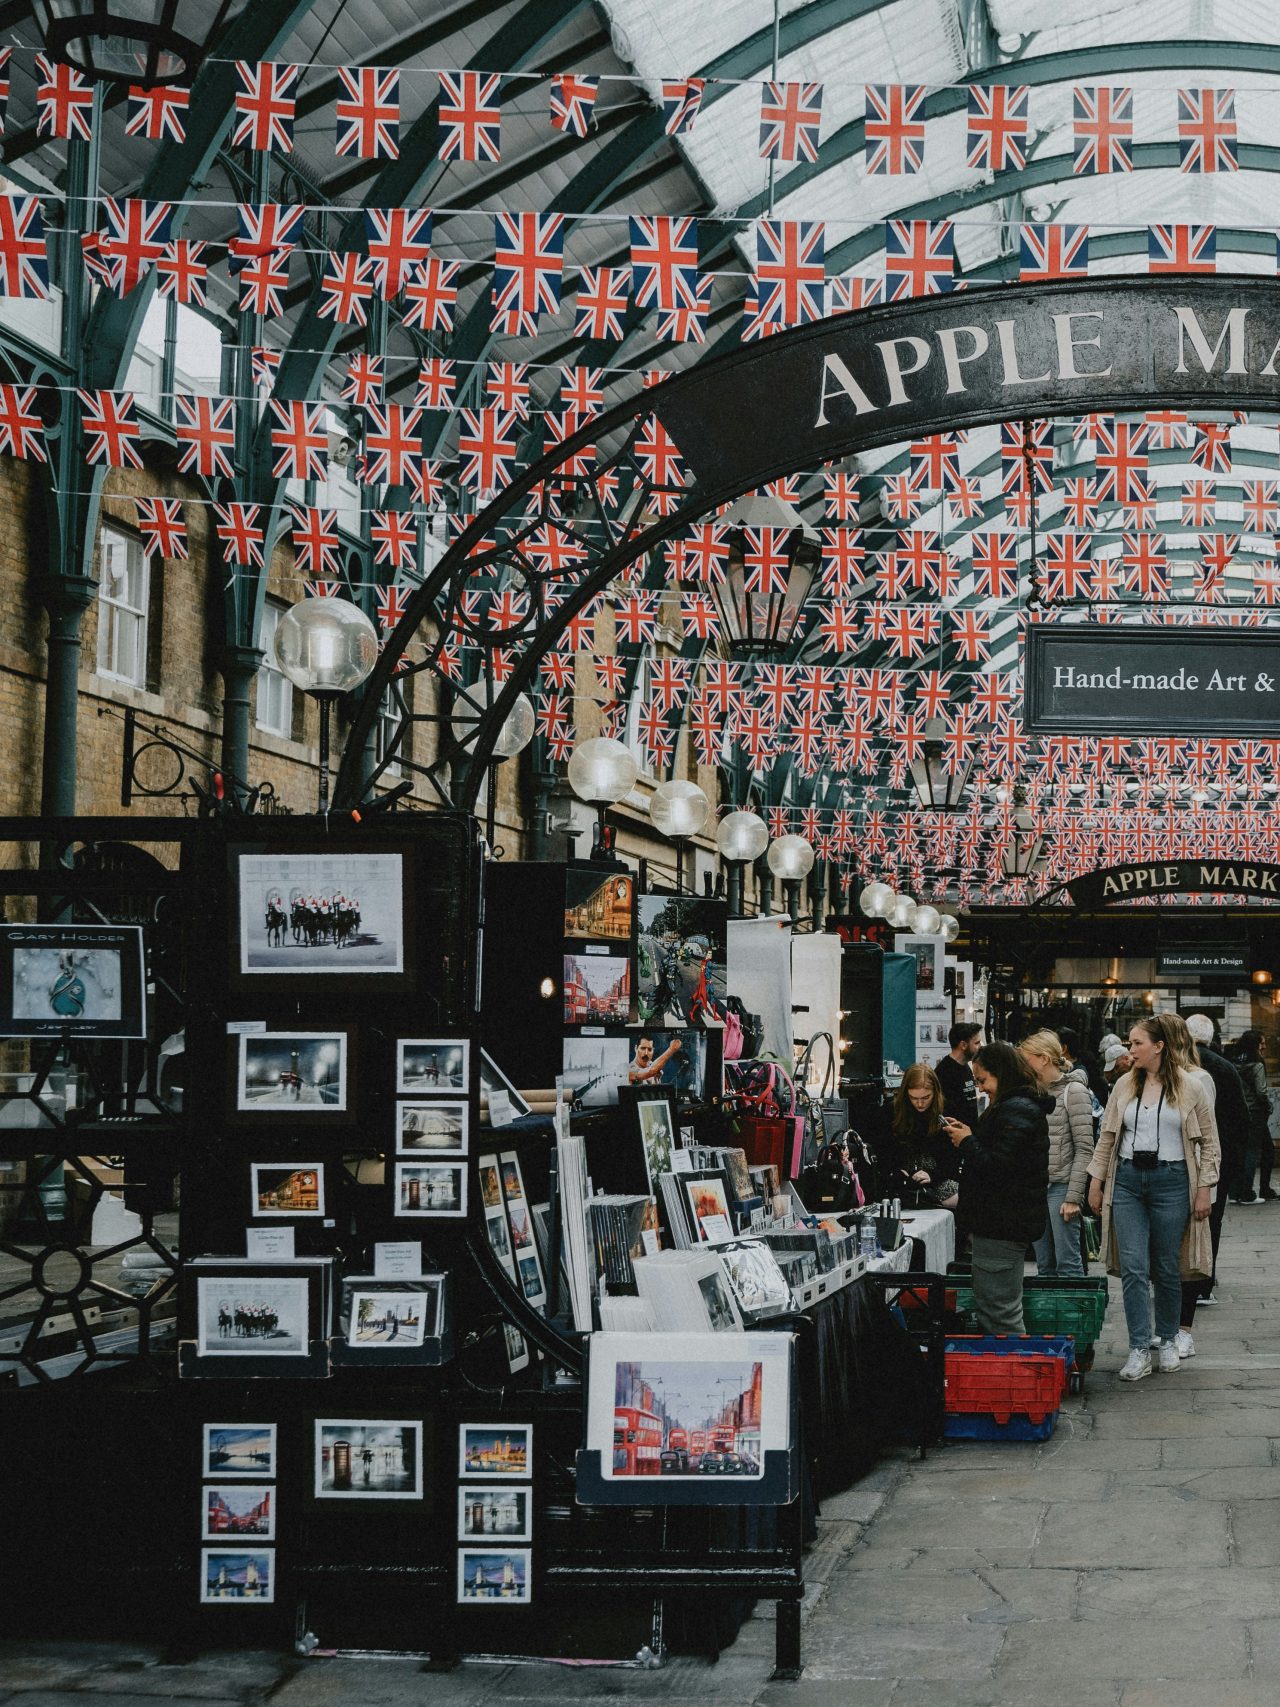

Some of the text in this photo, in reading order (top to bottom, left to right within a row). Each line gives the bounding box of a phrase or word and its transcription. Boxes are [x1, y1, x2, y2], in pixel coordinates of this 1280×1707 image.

[813, 311, 1114, 428] APPLE
[1053, 666, 1199, 690] Hand-made
[1206, 668, 1247, 692] Art
[1254, 673, 1275, 692] &
[1102, 866, 1181, 896] APPLE
[1163, 957, 1200, 965] Hand-made
[1201, 957, 1212, 965] Art
[1221, 957, 1243, 966] Design
